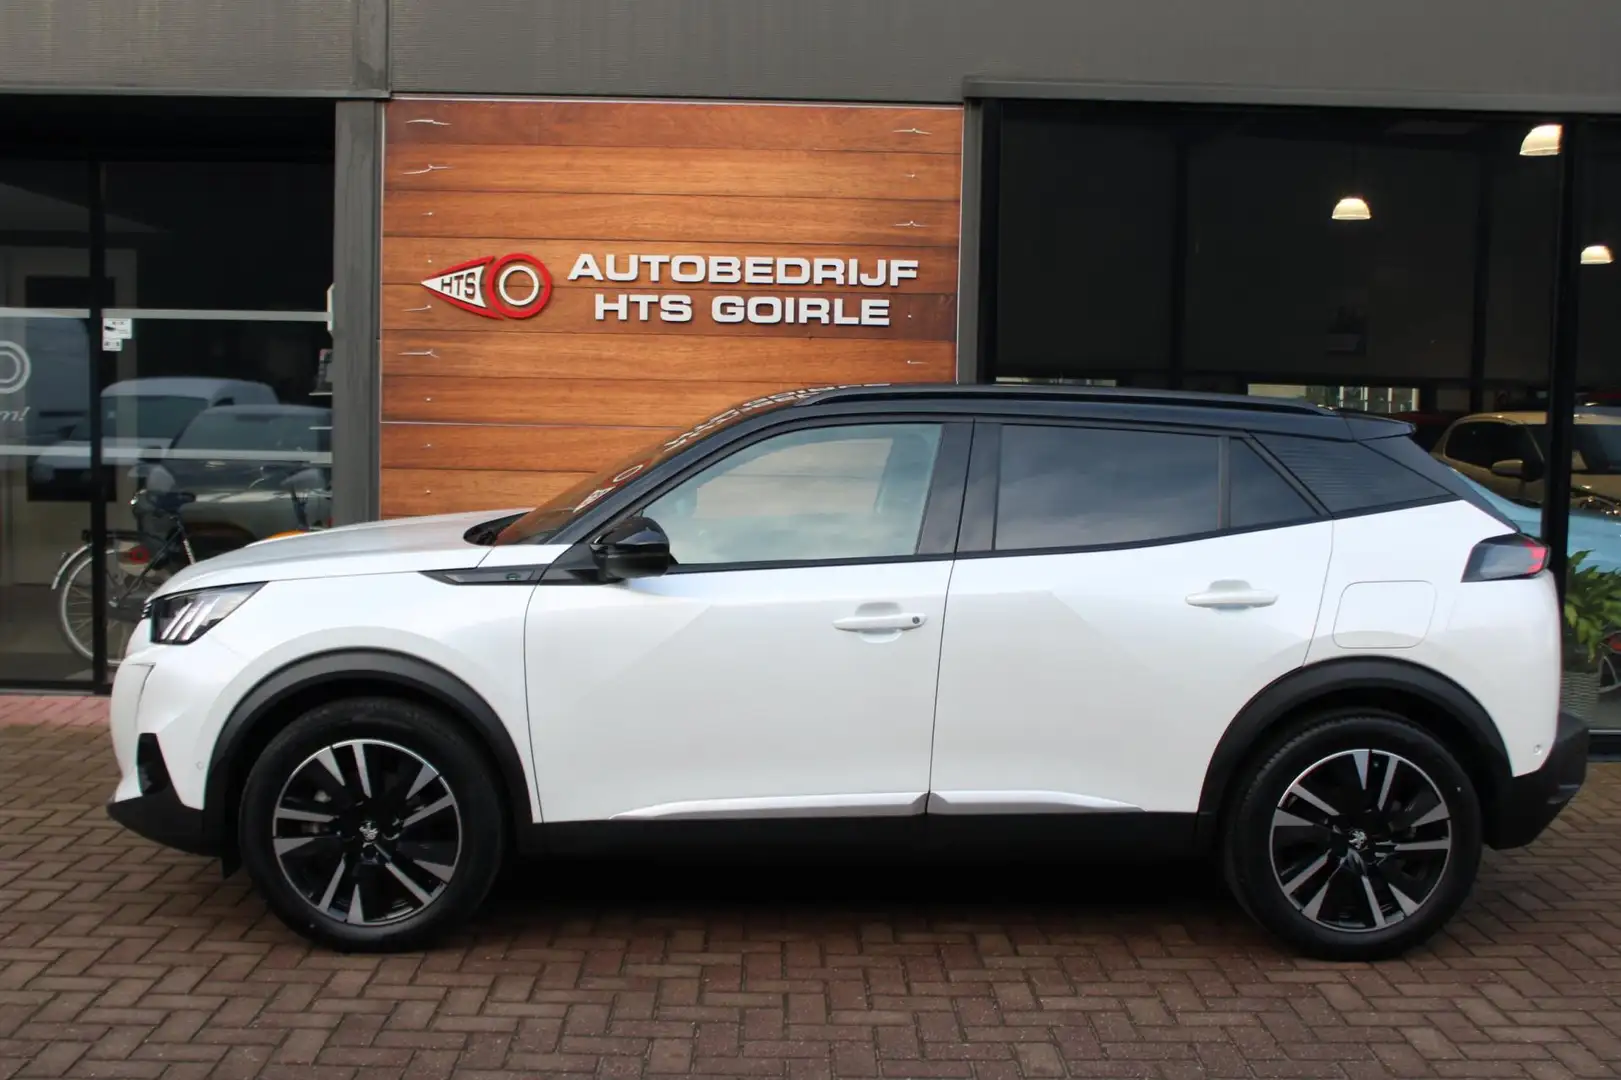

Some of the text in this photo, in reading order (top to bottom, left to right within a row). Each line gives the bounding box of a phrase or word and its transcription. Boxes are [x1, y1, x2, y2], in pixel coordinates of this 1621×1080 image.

[440, 271, 476, 300] HTS
[567, 253, 919, 287] AUTOBEDRIJF
[594, 293, 890, 326] HTS GOIRLE
